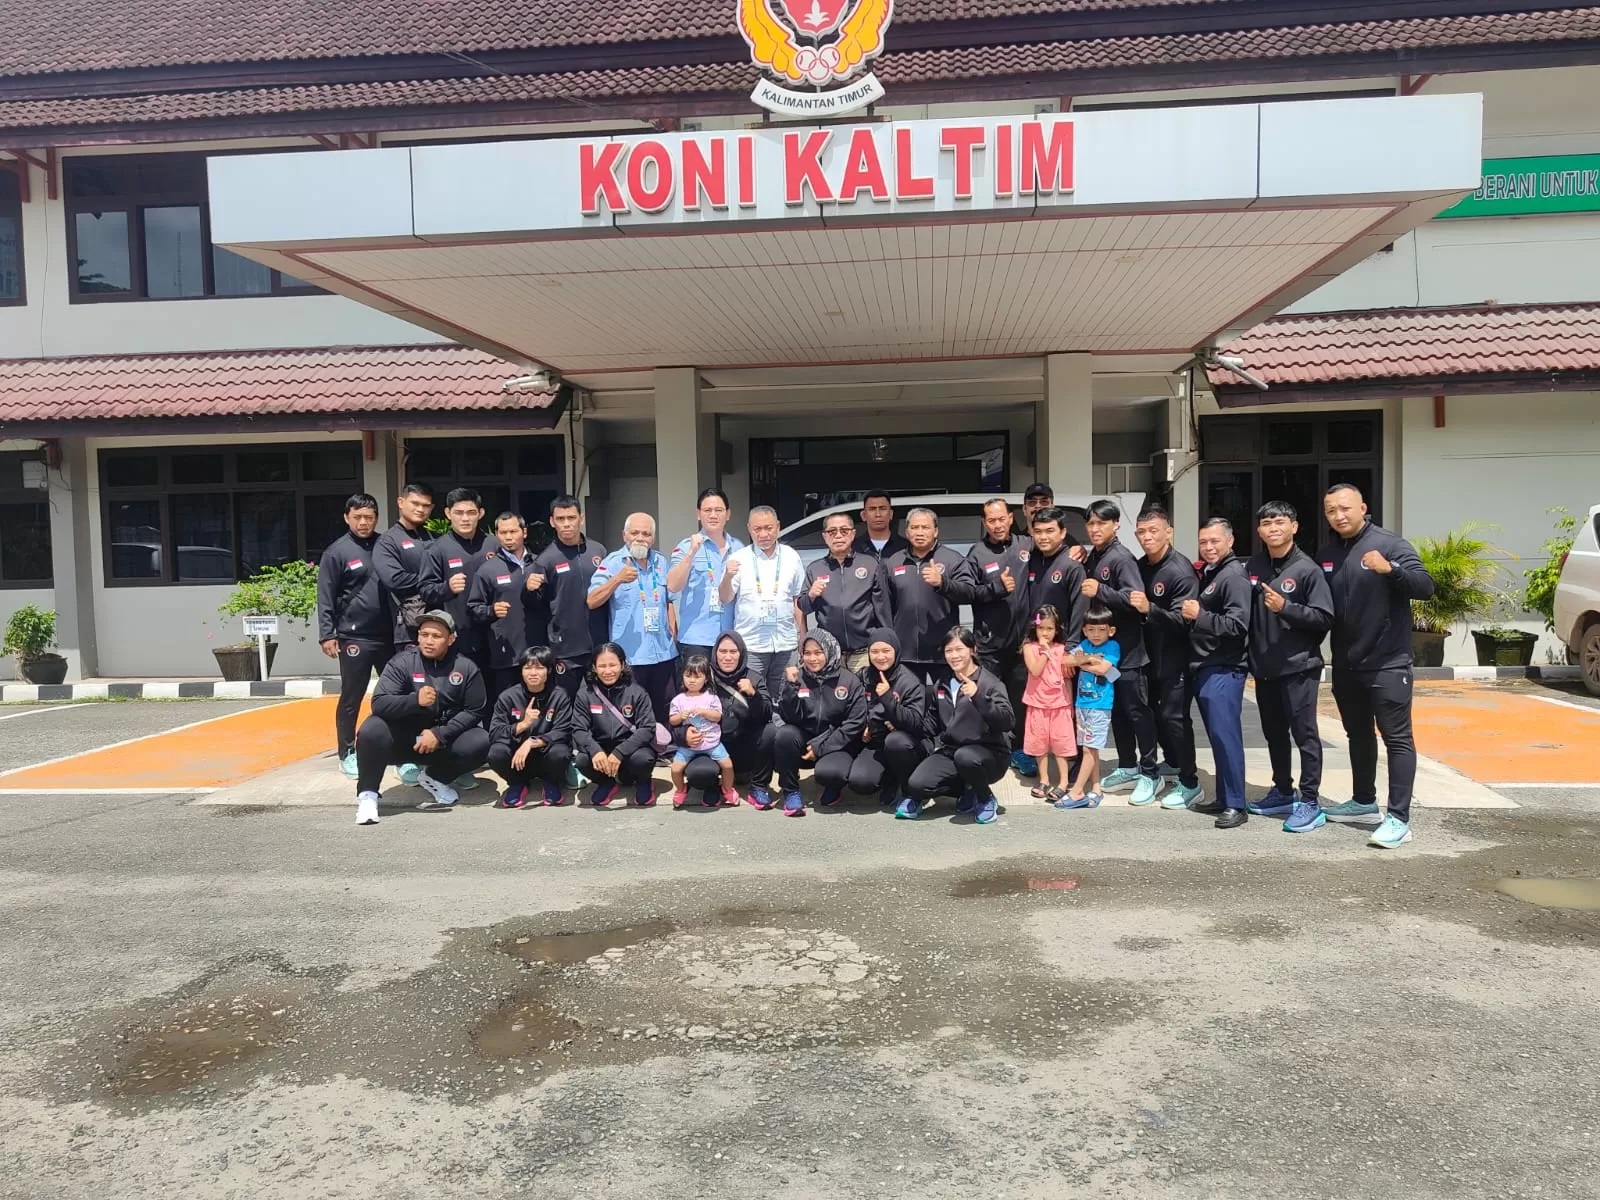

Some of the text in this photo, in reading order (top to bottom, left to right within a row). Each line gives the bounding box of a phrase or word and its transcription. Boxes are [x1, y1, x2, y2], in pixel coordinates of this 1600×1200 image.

[761, 84, 873, 109] KALIMANTAN TIMUR
[579, 121, 1076, 215] KONI KALTIM
[1540, 170, 1599, 196] UNTUK
